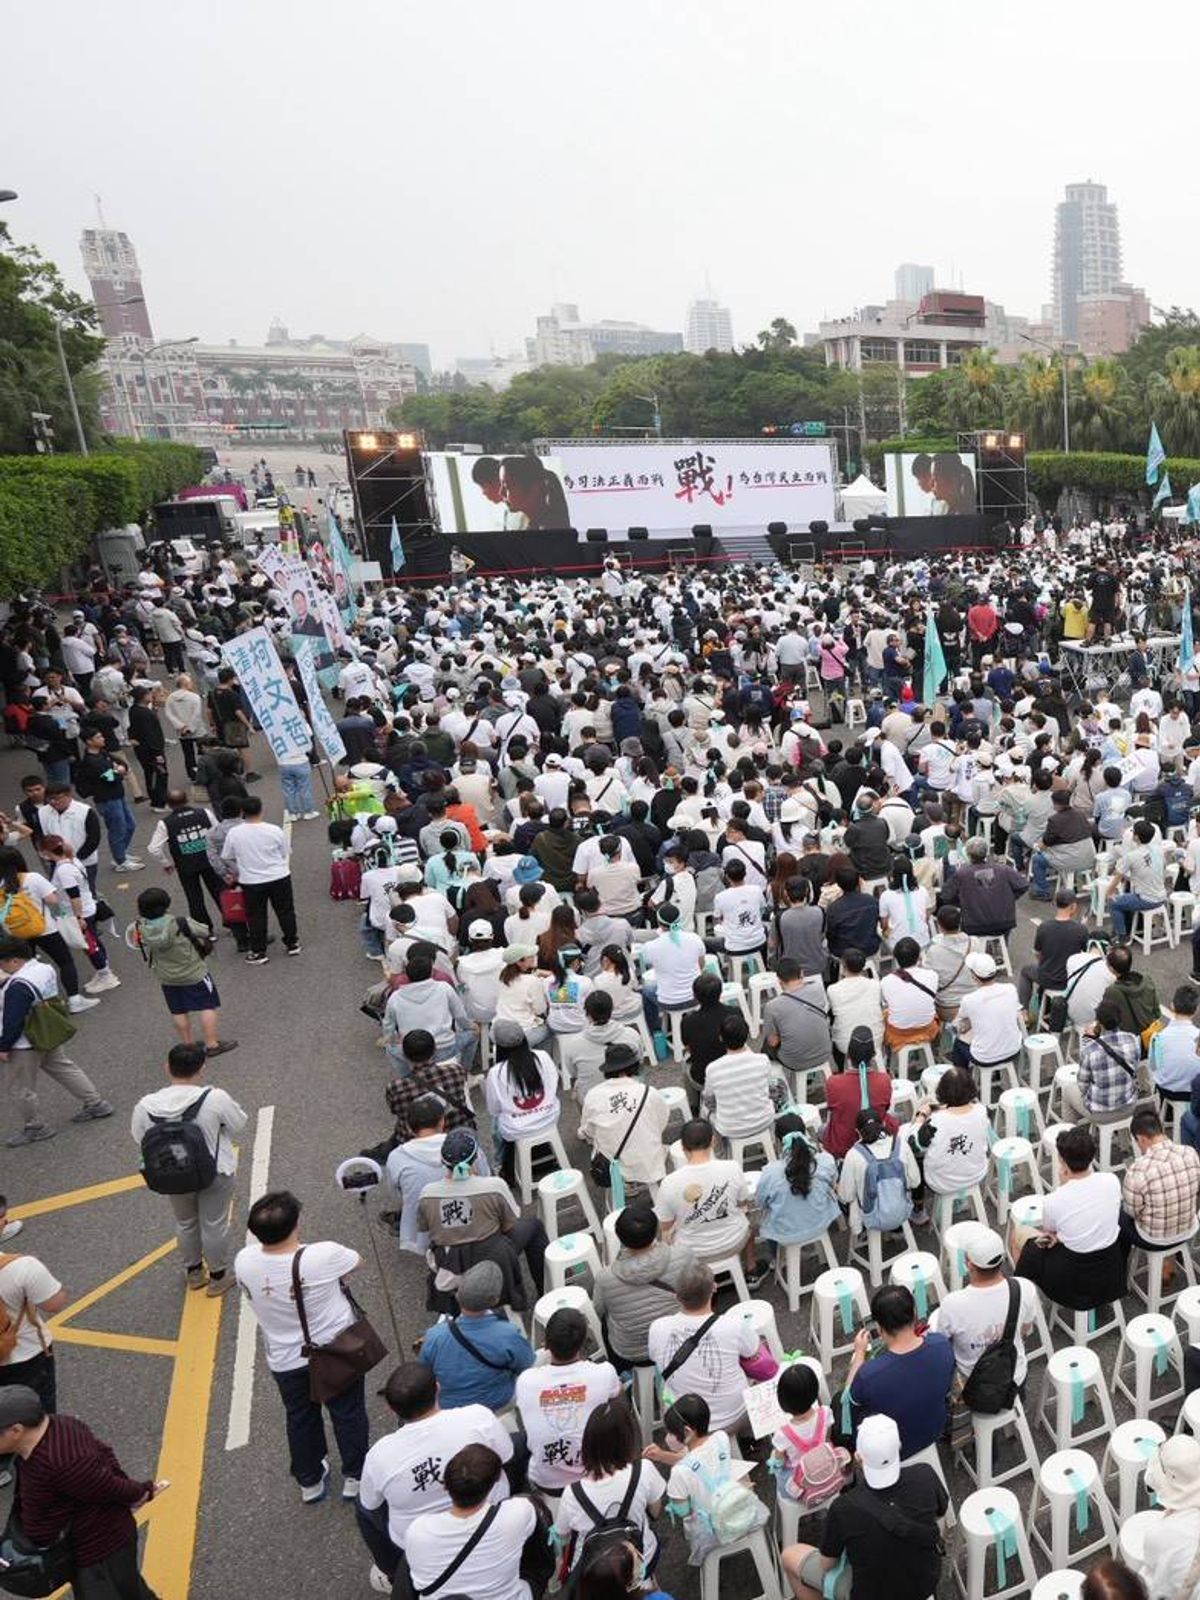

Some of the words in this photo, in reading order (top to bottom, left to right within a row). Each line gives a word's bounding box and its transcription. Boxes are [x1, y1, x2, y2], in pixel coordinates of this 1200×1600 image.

[674, 451, 732, 505] 戰!
[249, 638, 308, 747] 柯文哲
